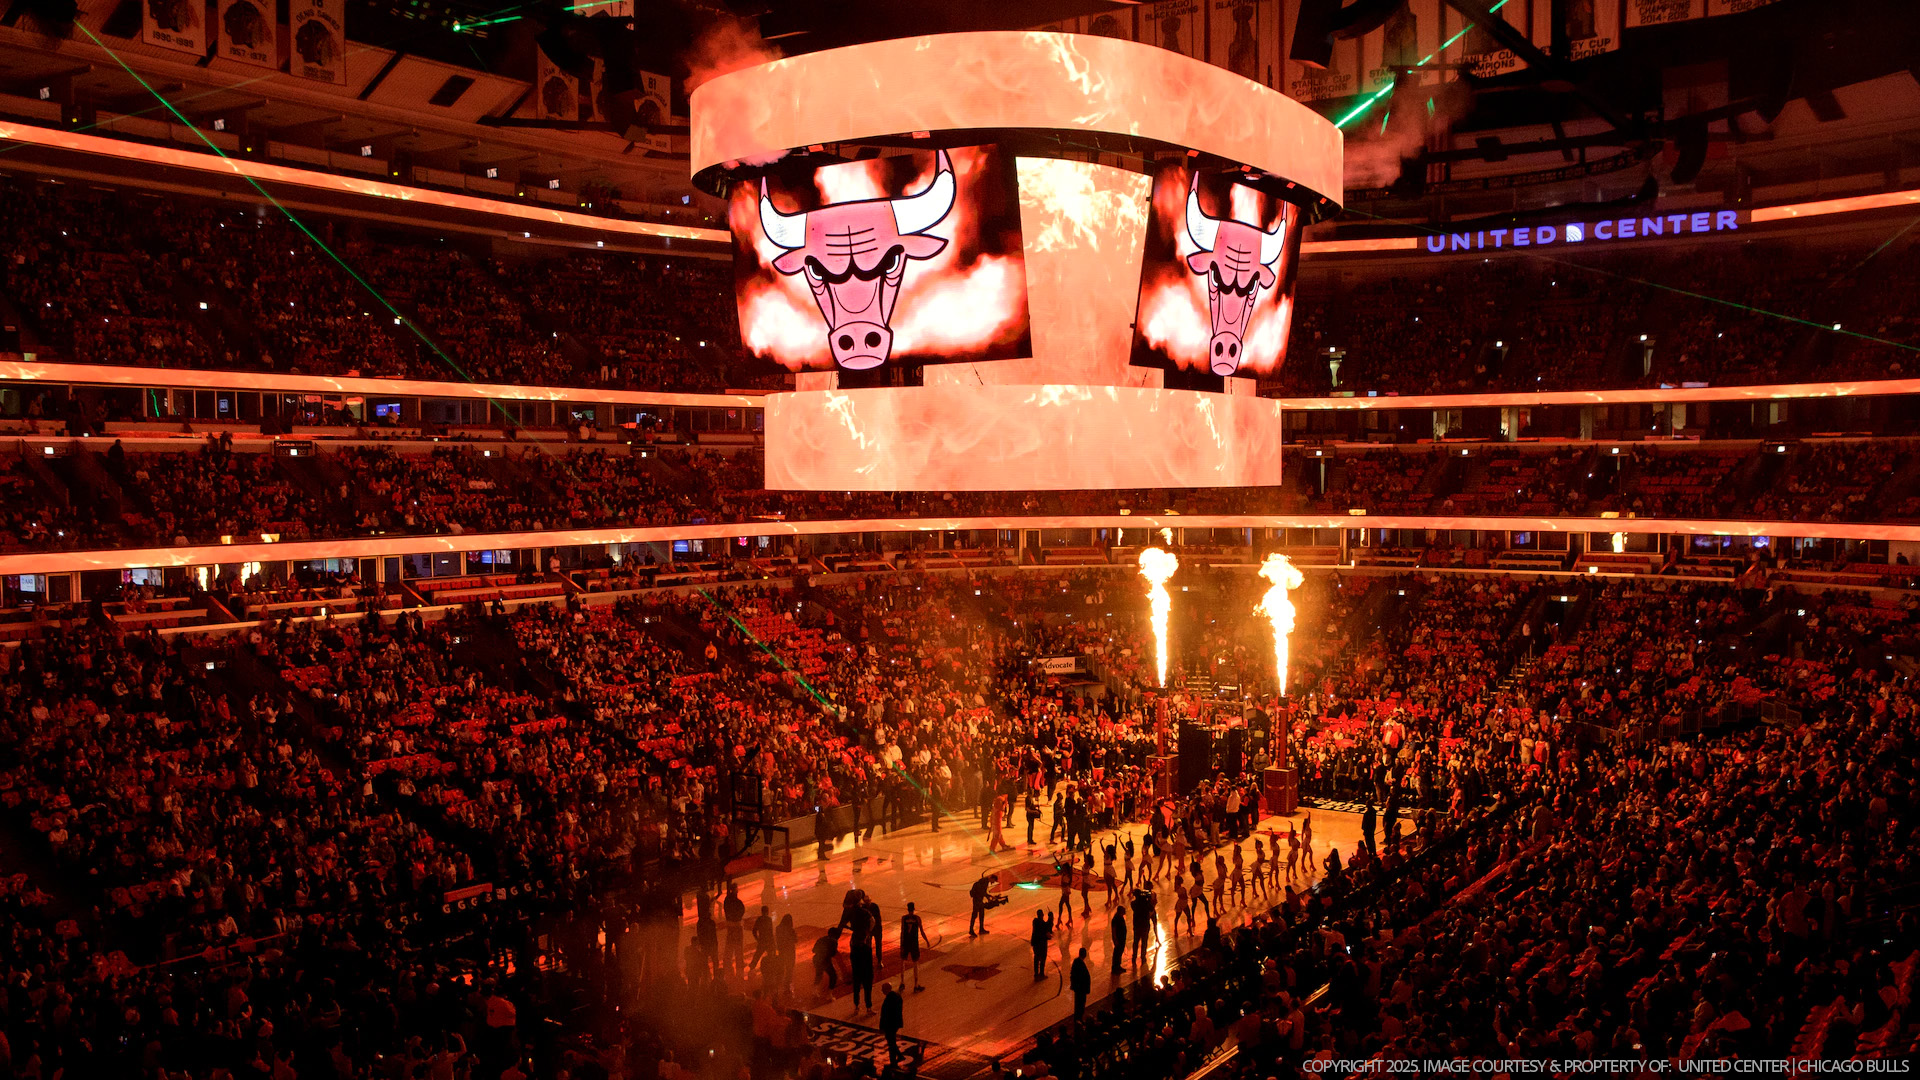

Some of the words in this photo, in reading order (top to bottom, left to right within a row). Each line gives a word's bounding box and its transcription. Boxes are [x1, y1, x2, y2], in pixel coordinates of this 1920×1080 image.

[1588, 37, 1611, 49] CUP
[1291, 76, 1330, 90] STANLEY
[1332, 73, 1352, 85] CUP
[1294, 82, 1349, 98] CHAMPIONS
[1427, 226, 1557, 252] UNITED
[1594, 210, 1738, 240] CENTER
